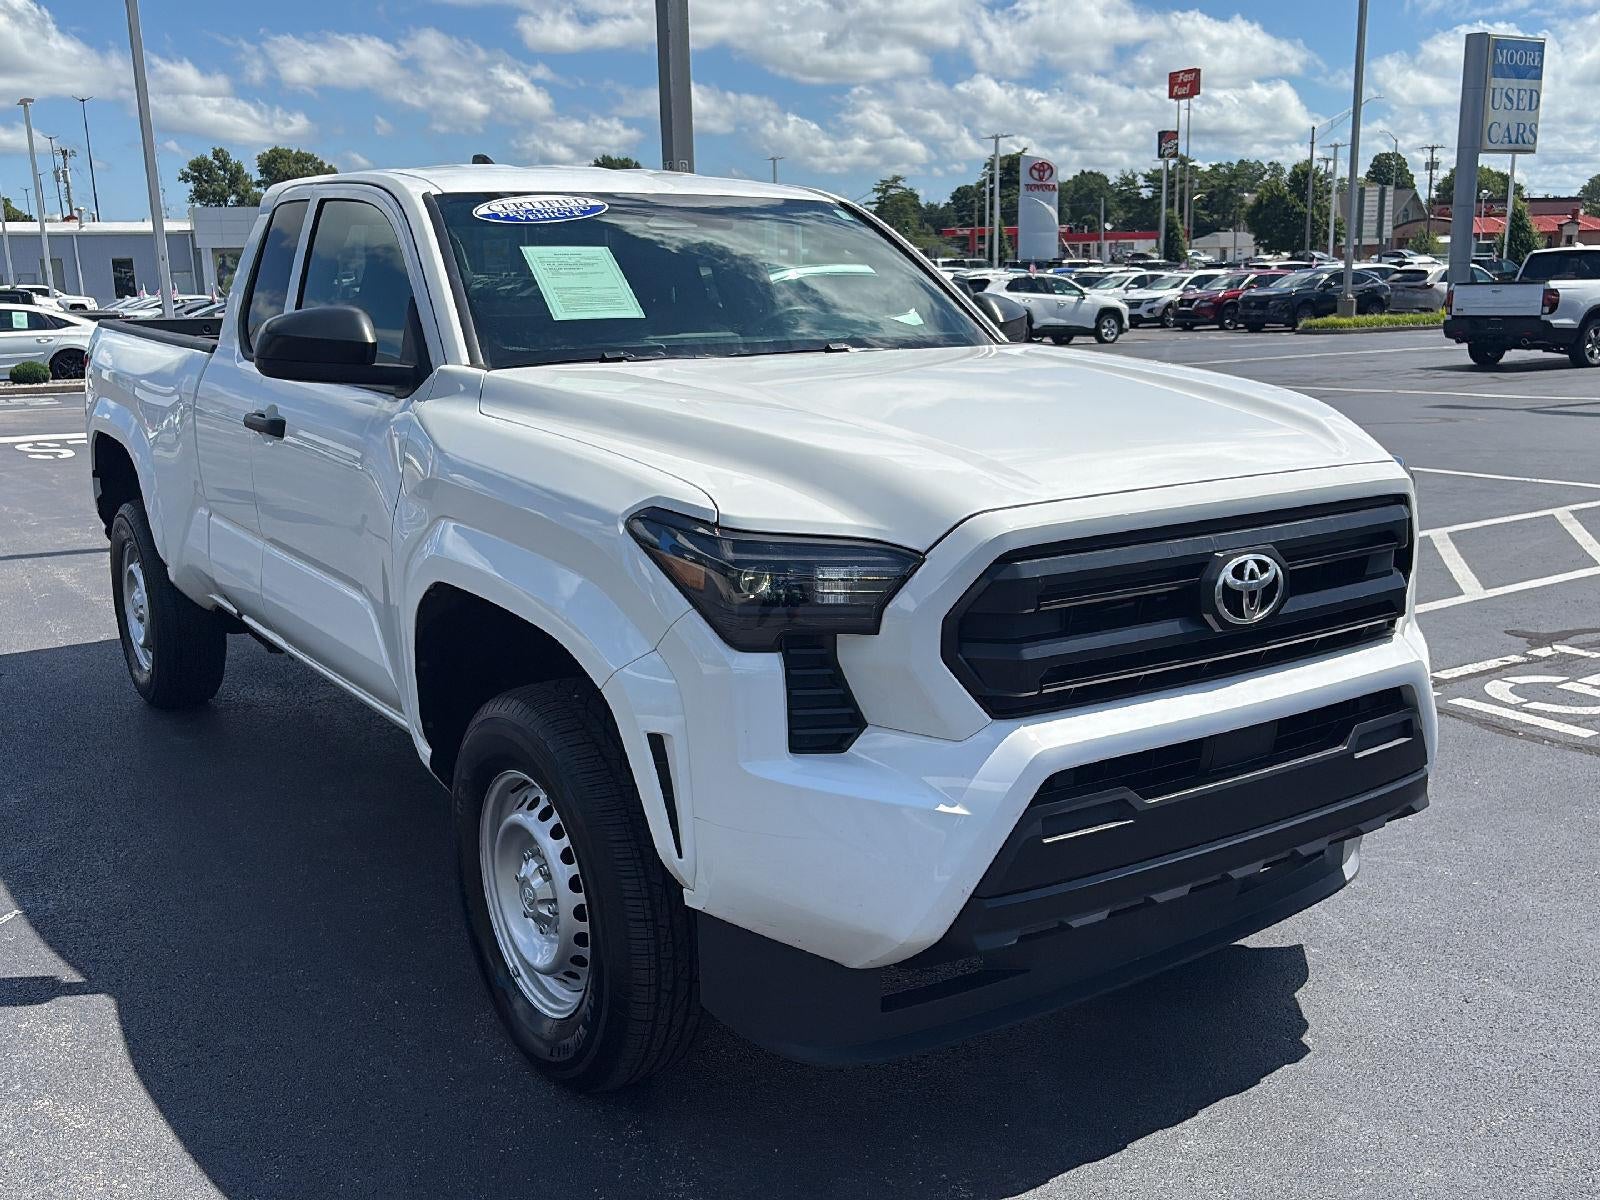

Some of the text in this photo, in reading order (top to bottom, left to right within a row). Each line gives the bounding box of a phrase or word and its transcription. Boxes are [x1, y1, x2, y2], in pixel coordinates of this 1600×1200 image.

[1495, 48, 1543, 67] MOORE
[1177, 71, 1196, 83] Fast
[1172, 82, 1191, 97] Fuel
[1490, 87, 1541, 112] USED
[1487, 121, 1538, 145] CARS
[1024, 183, 1057, 192] TOYOTA
[487, 199, 590, 212] CERTIFIED
[515, 210, 585, 221] VEHICLE
